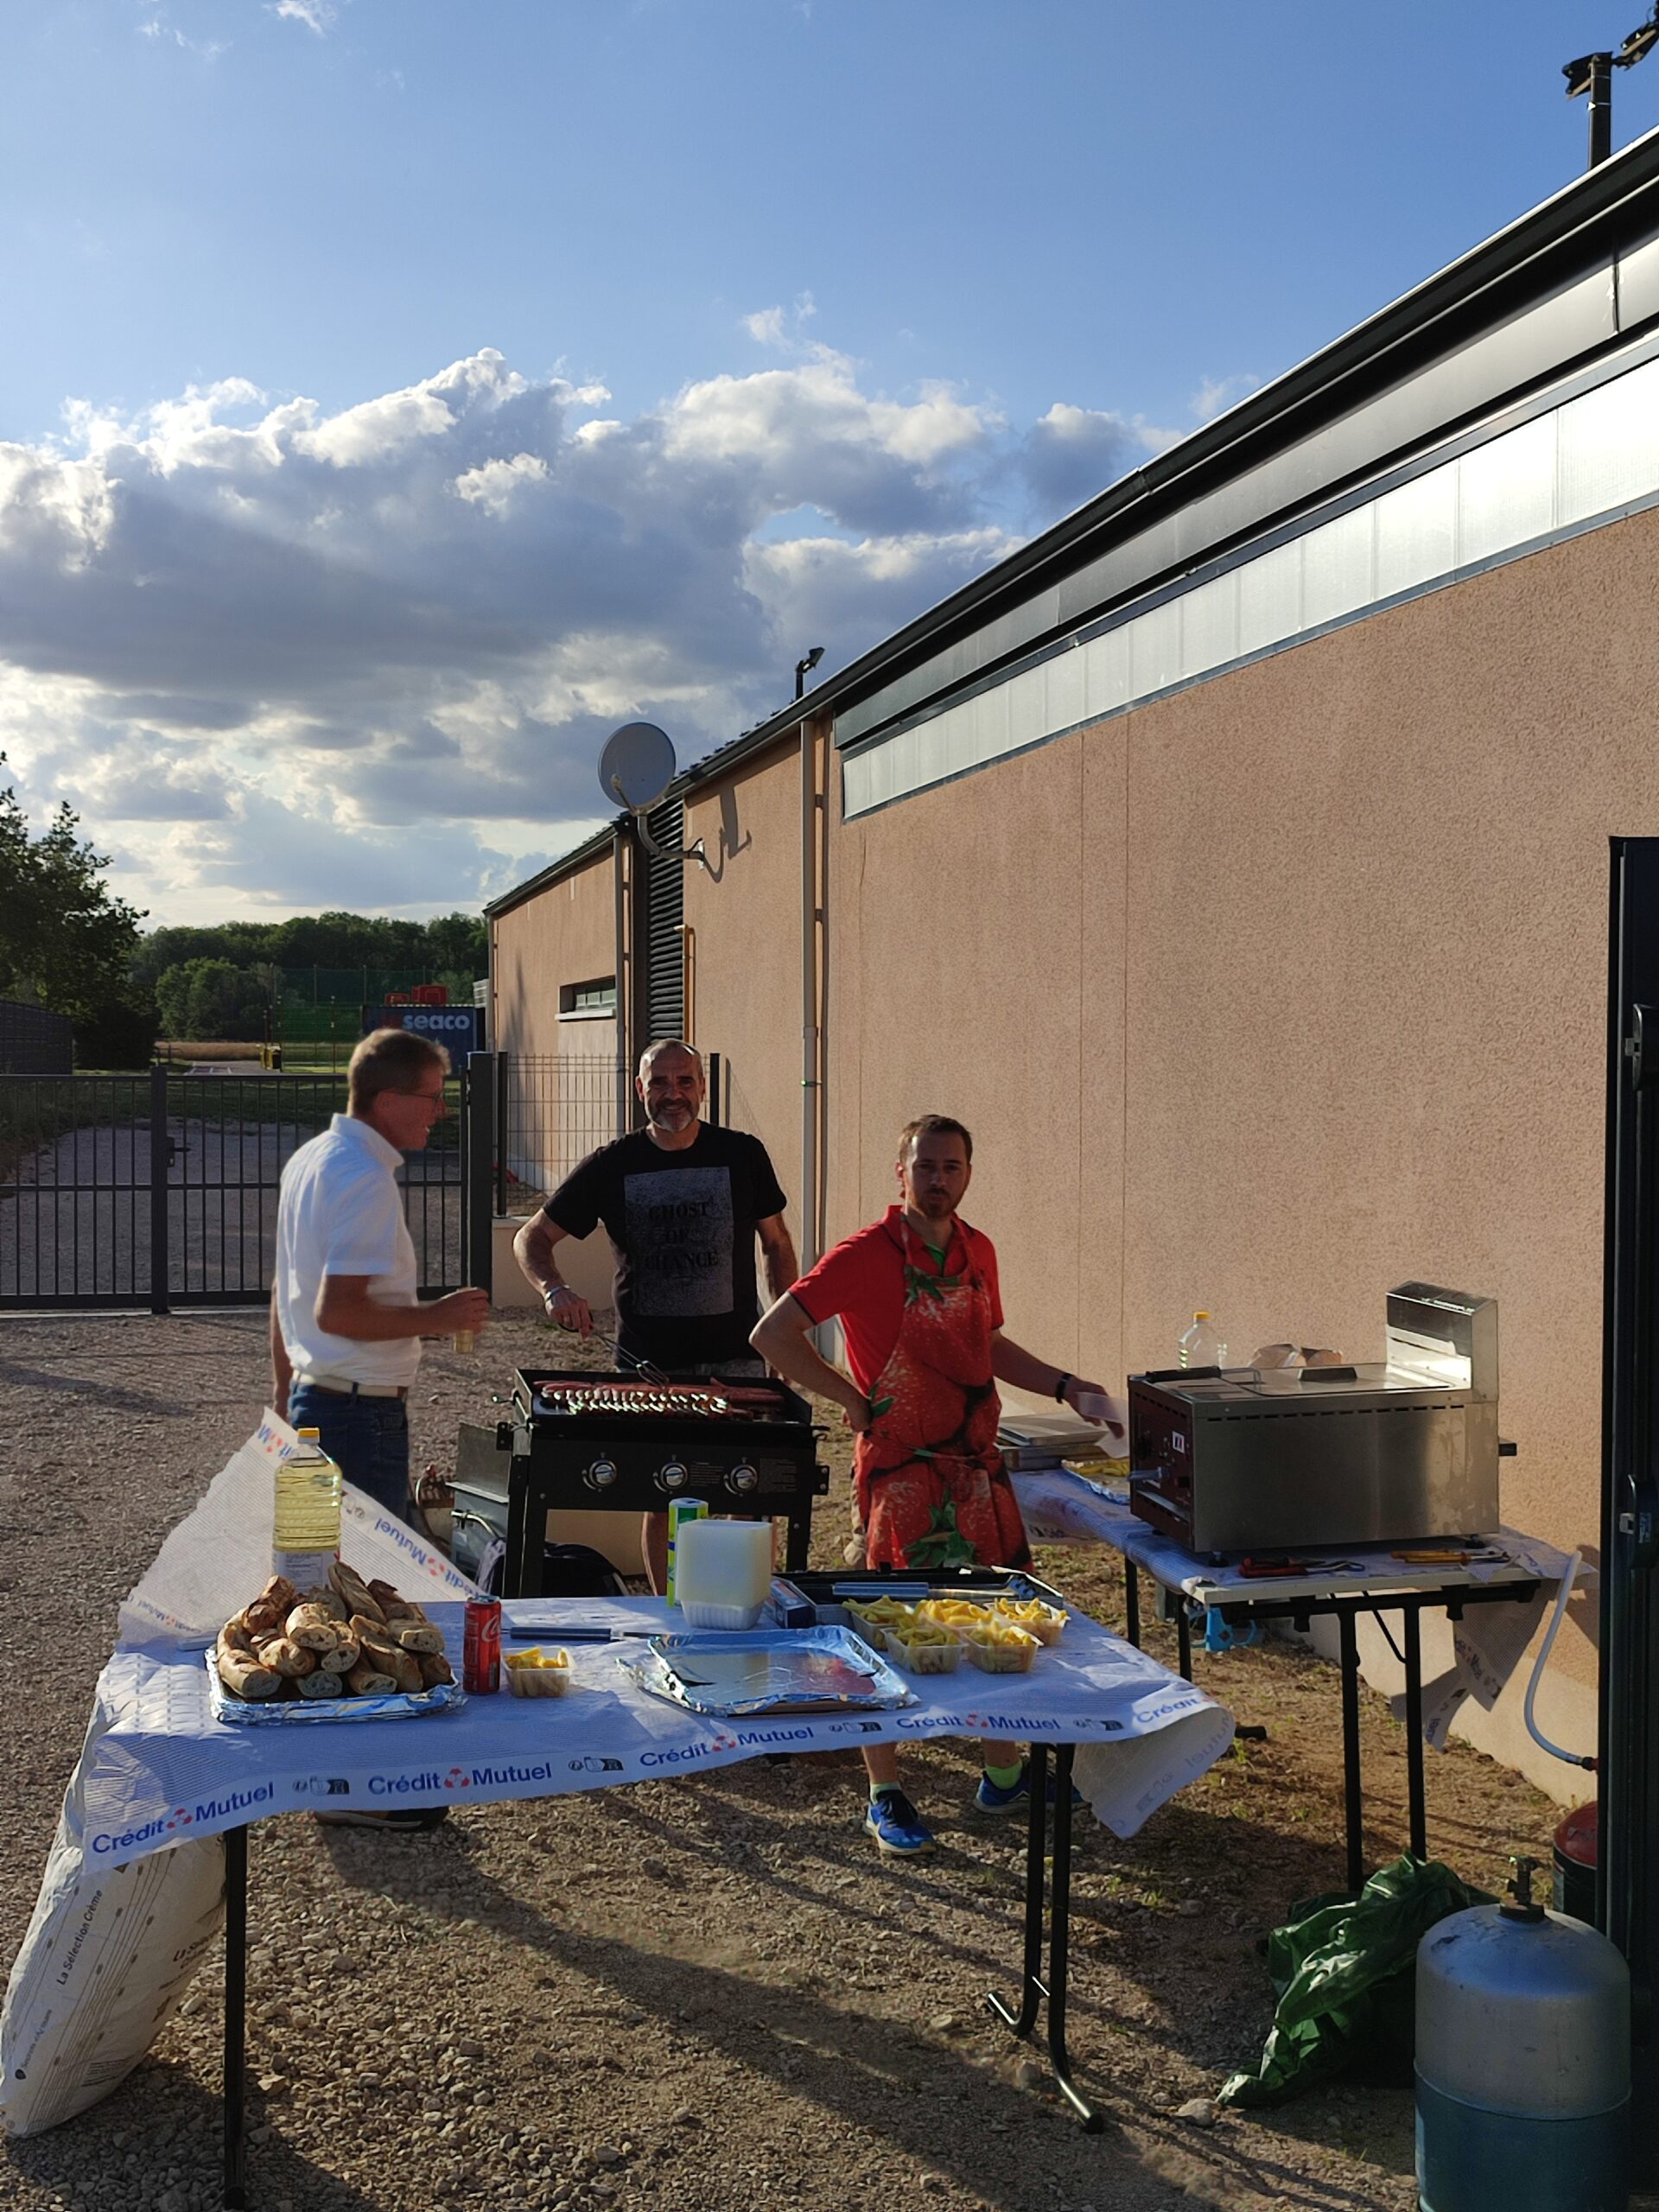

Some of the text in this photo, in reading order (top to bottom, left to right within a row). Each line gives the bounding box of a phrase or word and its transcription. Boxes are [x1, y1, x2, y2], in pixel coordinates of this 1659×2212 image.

[403, 1014, 471, 1030] seaco
[648, 1201, 709, 1221] GHOST
[374, 1518, 428, 1567] Mutuel
[896, 1714, 1061, 1731] Crédit Mutuel
[1136, 1698, 1201, 1724] Crédit
[639, 1726, 815, 1767] Crédit Mutuel
[368, 1762, 553, 1796] Crédit Mutuel
[92, 1781, 275, 1853] Crédit Mutuel
[56, 1890, 103, 1986] La Sélection Crème
